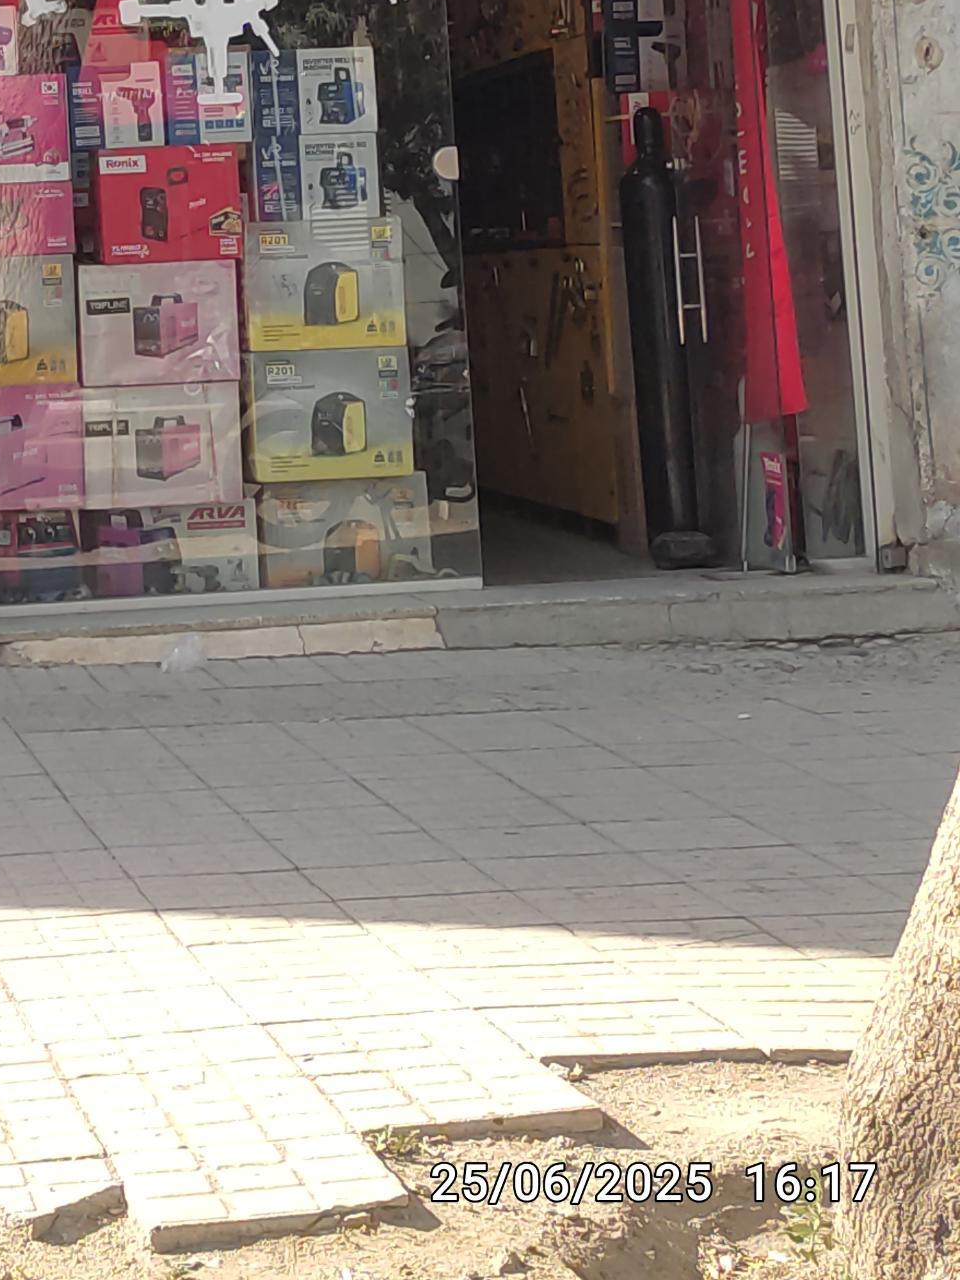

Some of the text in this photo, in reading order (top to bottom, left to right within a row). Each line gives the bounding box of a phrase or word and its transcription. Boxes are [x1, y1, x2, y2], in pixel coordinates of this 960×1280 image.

[105, 157, 140, 169] Ronix
[268, 366, 294, 376] R201
[187, 505, 246, 521] ARVA
